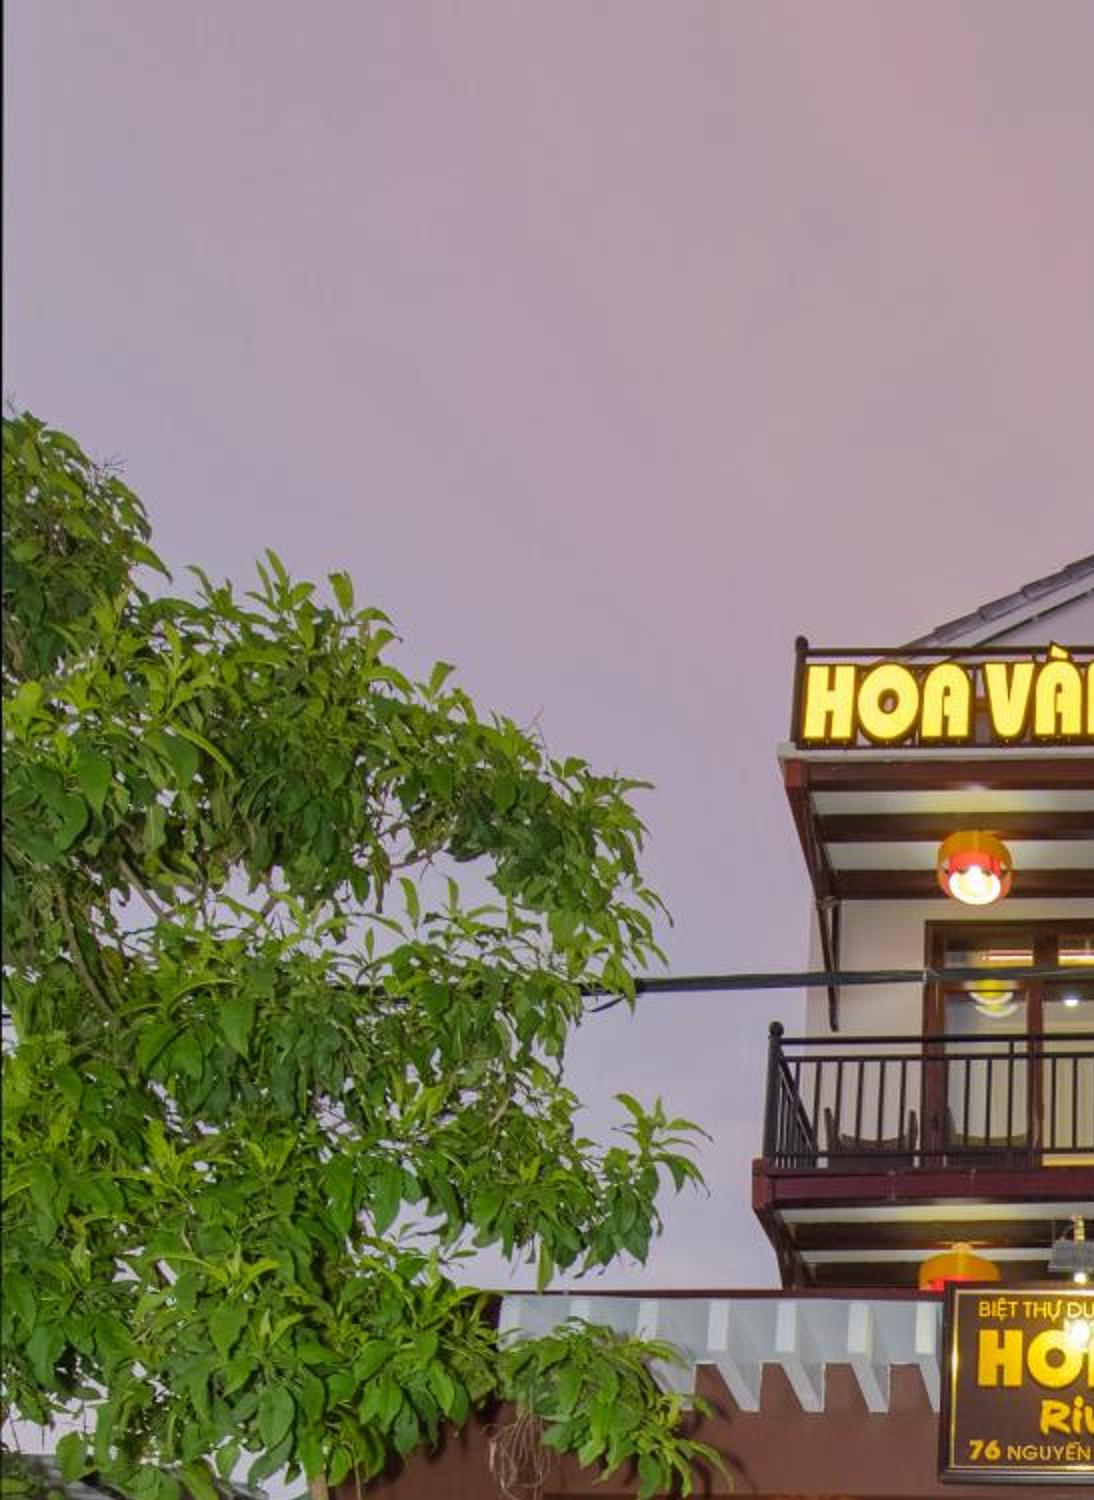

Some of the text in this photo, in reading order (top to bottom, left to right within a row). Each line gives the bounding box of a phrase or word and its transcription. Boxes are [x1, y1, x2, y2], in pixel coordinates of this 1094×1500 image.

[802, 663, 971, 740] HOA
[978, 1297, 1019, 1321] BIỆT
[1023, 1300, 1063, 1322] THỰ
[968, 1439, 1001, 1461] 76
